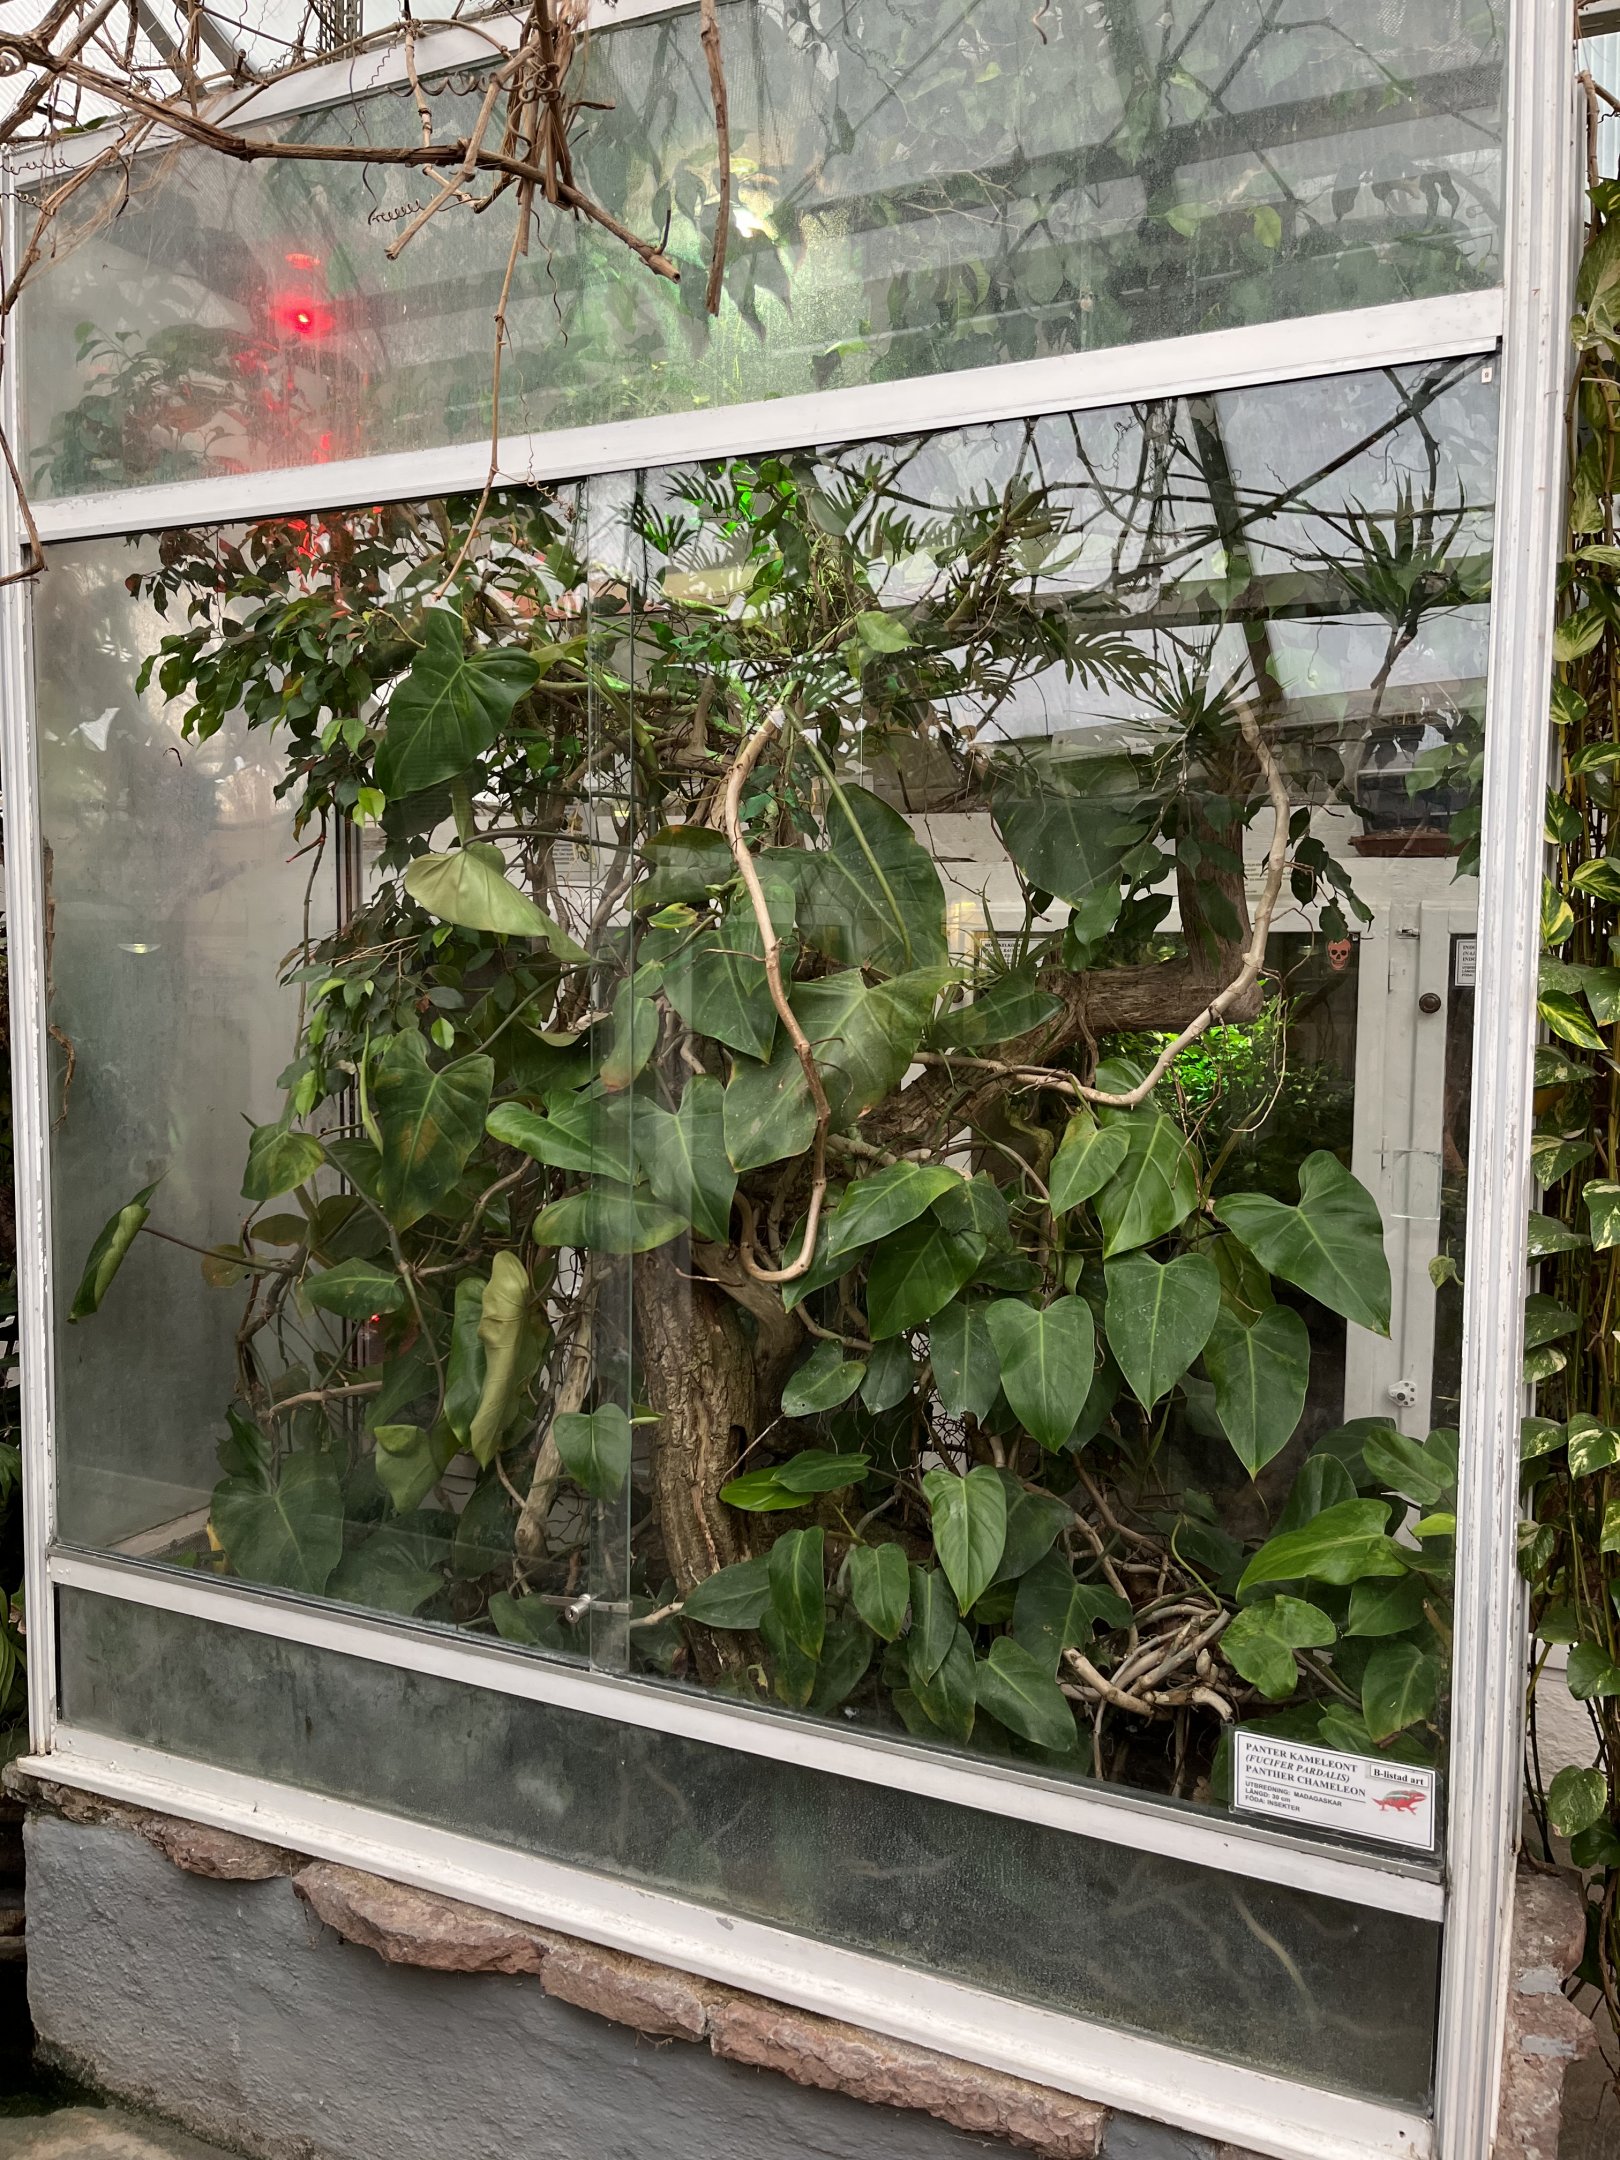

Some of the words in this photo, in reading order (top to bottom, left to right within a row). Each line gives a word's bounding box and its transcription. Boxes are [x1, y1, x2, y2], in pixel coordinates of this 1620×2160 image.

[1245, 1754, 1294, 1771] (FUCIFER
[1296, 1764, 1350, 1784] PARDALIS)
[1246, 1742, 1287, 1758] PANTER
[1289, 1752, 1358, 1773] KAMELEONT
[1246, 1765, 1295, 1782] PANTHER
[1297, 1775, 1366, 1797] CHAMELEON
[1373, 1768, 1408, 1782] B-listad
[1410, 1778, 1424, 1786] art
[1245, 1787, 1270, 1798] LÄNGD:
[1245, 1780, 1291, 1796] UTBREDNING:
[1293, 1791, 1343, 1807] MADAGASKAR
[1245, 1793, 1266, 1805] FÖDA:
[1267, 1799, 1301, 1812] INSEKTER
